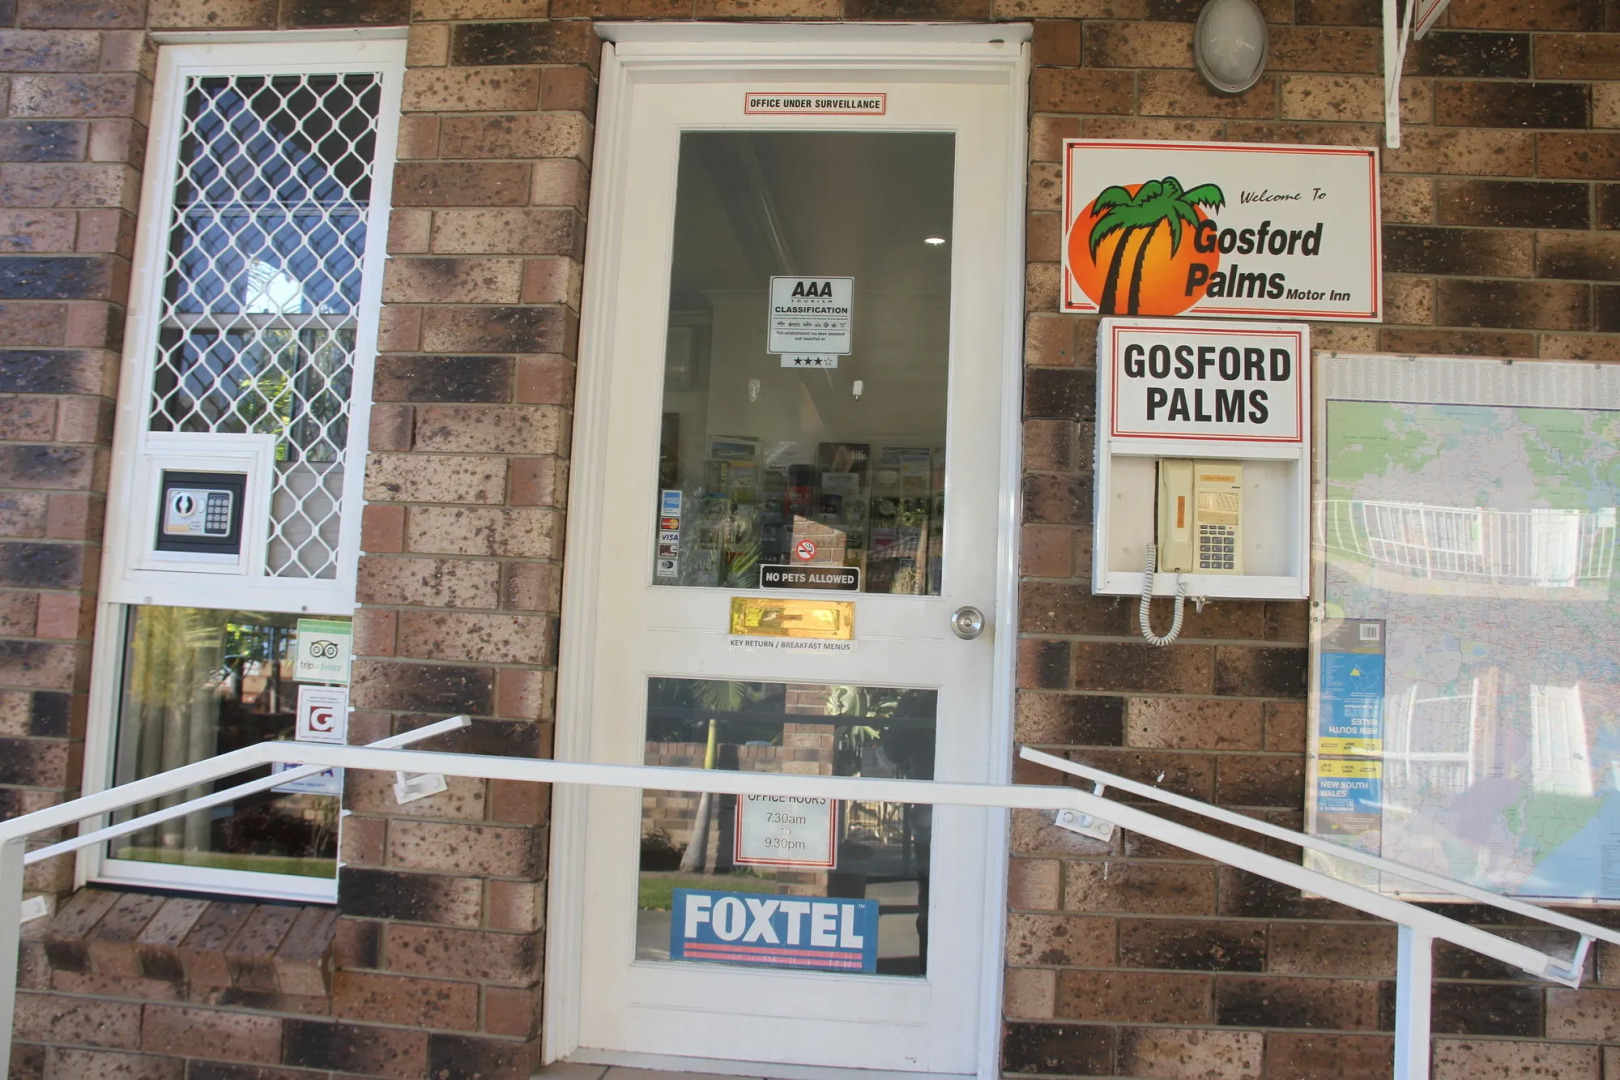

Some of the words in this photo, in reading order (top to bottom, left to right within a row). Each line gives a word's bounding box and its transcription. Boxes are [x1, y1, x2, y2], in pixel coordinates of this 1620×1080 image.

[750, 98, 780, 108] OFFICE
[783, 99, 812, 108] UNDER
[814, 99, 881, 109] SURVEILLANCE
[1240, 190, 1302, 205] Welcome
[1312, 187, 1327, 201] To
[1193, 219, 1324, 257] Gosford
[1184, 262, 1286, 300] Palms
[1286, 288, 1326, 301] Motor
[1329, 289, 1351, 302] Inn
[791, 281, 833, 297] AAA
[775, 306, 848, 314] CLASSIFICATION
[1124, 343, 1291, 382] GOSFORD
[1146, 387, 1269, 424] PALMS
[766, 572, 780, 582] NO
[782, 573, 806, 583] PETS
[808, 574, 855, 584] ALLOWED
[730, 639, 743, 647] KEY
[745, 640, 774, 648] RETURN
[781, 641, 821, 649] BREAKFAST
[823, 642, 851, 651] MENUS
[1351, 717, 1378, 726] WALES
[1328, 726, 1358, 735] SOUTH
[1360, 727, 1378, 735] NEW
[1320, 780, 1339, 788] NEW
[1340, 781, 1369, 789] SOUTH
[1320, 789, 1347, 798] WALES
[766, 812, 806, 824] 7.30am
[764, 837, 806, 851] 9.30pm
[684, 894, 864, 949] FOXTEL
